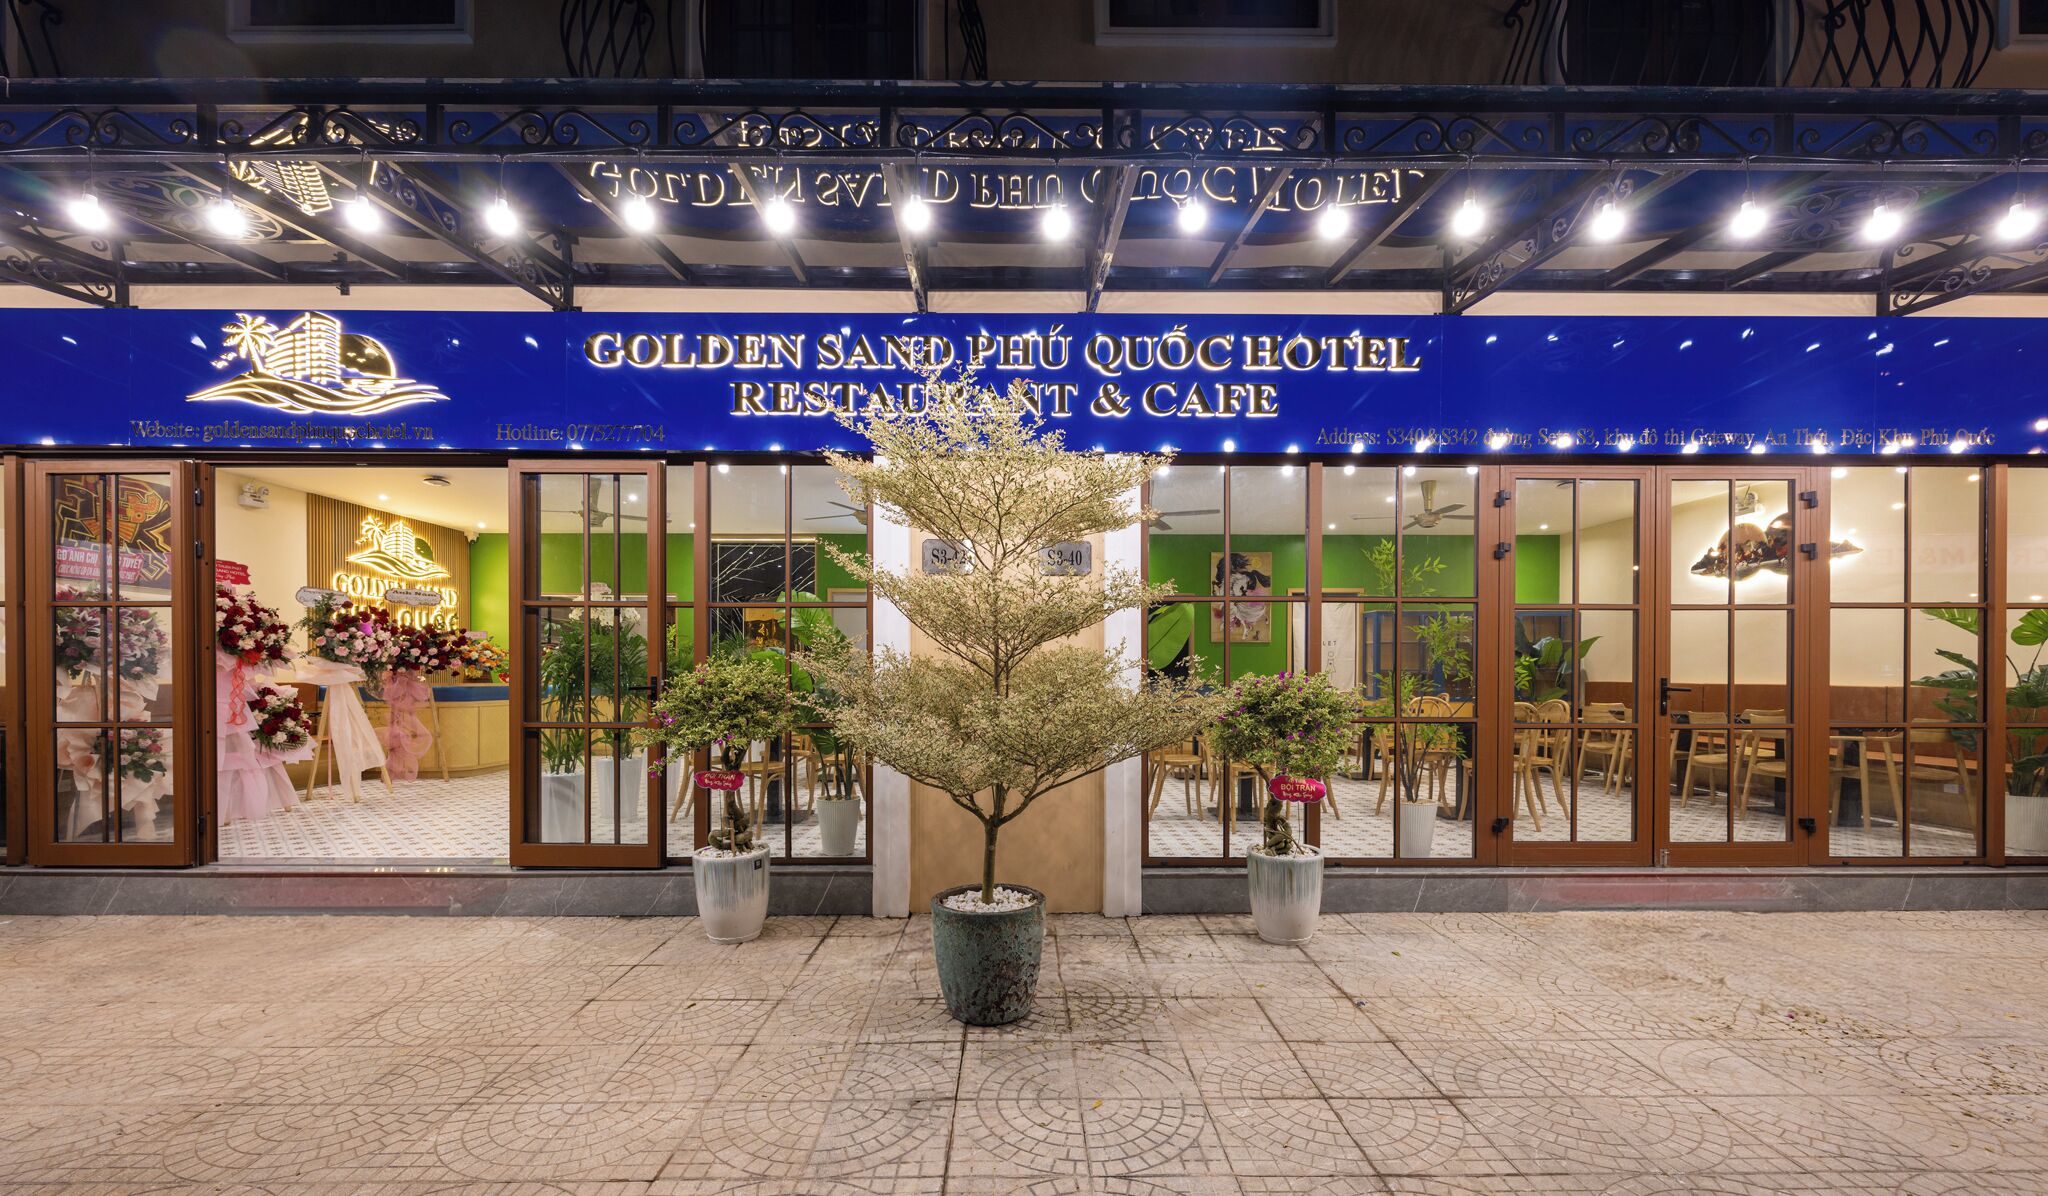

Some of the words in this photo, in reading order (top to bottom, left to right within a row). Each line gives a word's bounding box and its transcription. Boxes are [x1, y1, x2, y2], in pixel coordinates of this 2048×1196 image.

[583, 332, 806, 368] GOLDEN
[817, 332, 955, 370] SAND
[966, 324, 1073, 370] PHÚ
[1085, 324, 1235, 375] QUỐC
[1243, 335, 1422, 372] HOTEL
[1092, 381, 1132, 417] &
[1142, 381, 1280, 417] CAFE
[129, 420, 200, 438] Website:
[496, 423, 564, 441] Hotline:
[1316, 427, 1381, 445] Address:
[1765, 428, 1788, 445] An
[1920, 427, 1949, 446] Phú
[1047, 549, 1083, 566] S3-40
[333, 573, 406, 599] GOLD
